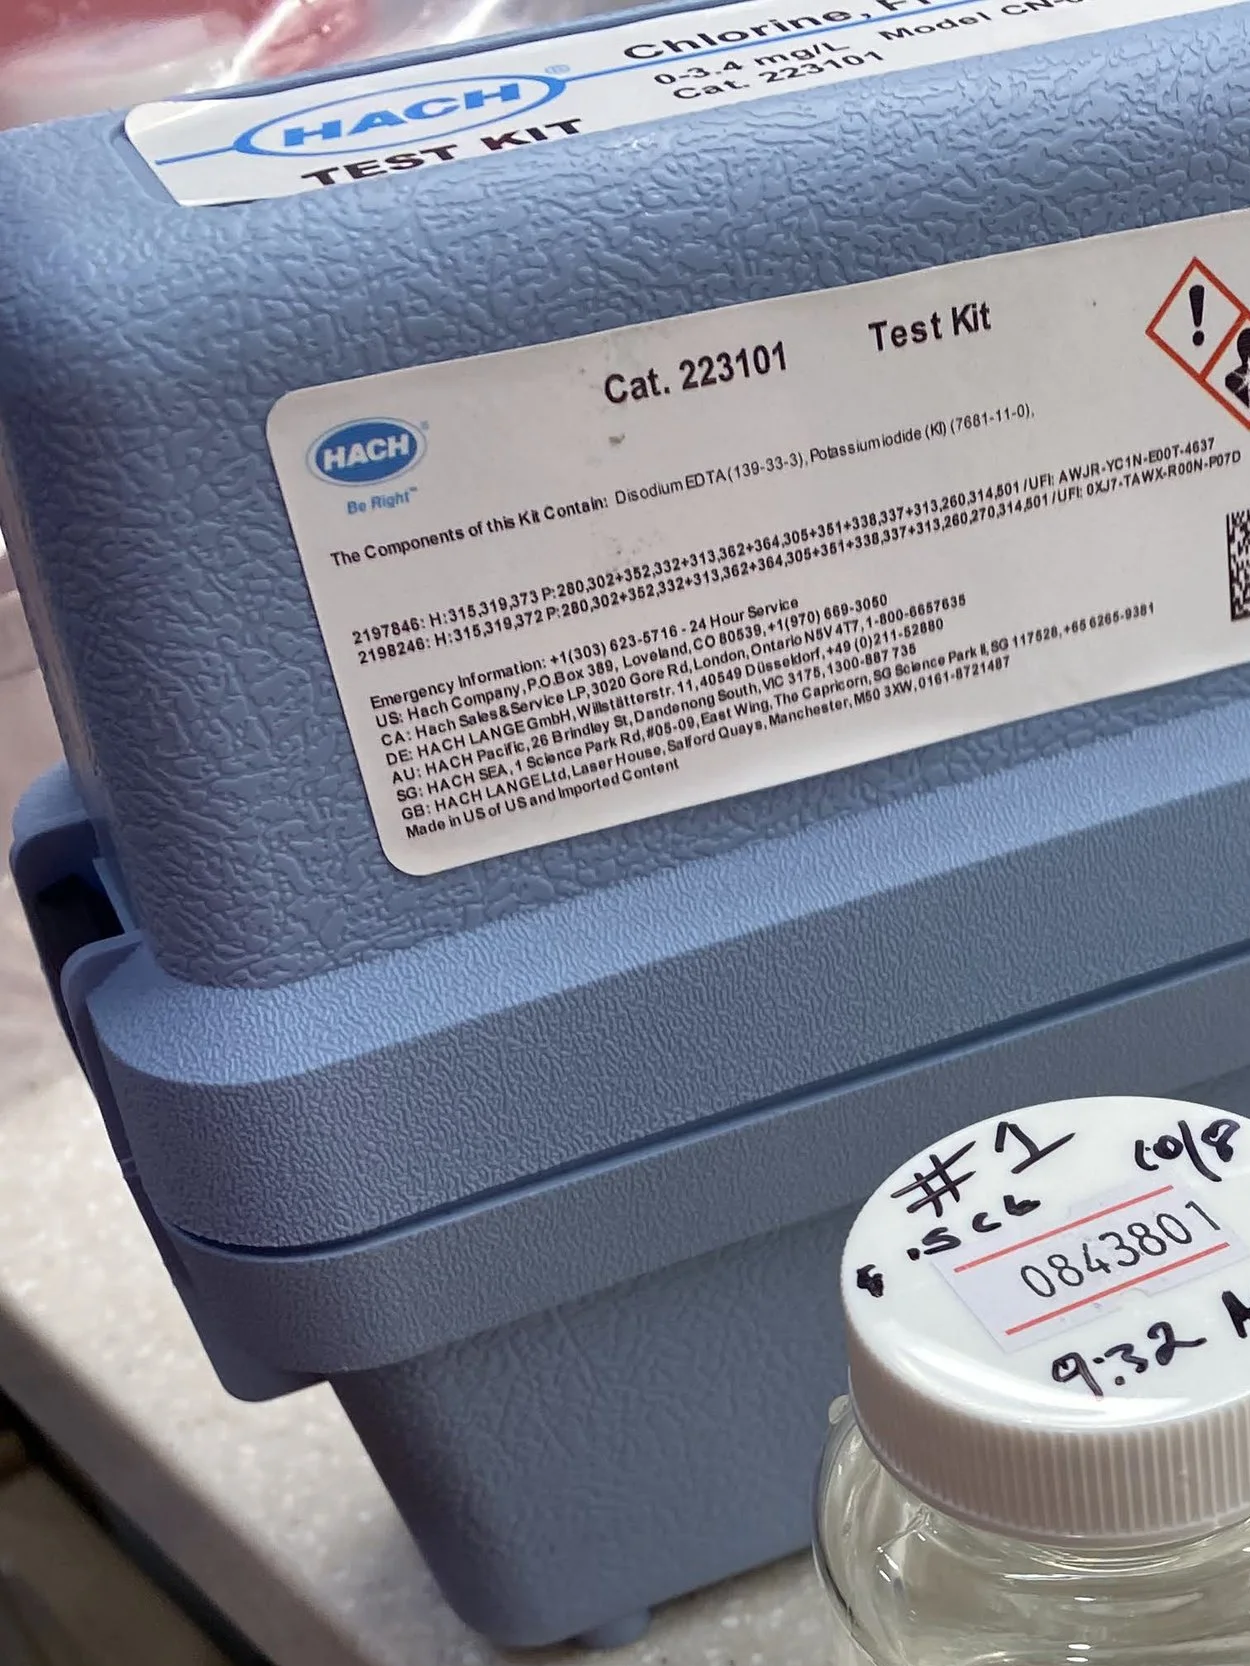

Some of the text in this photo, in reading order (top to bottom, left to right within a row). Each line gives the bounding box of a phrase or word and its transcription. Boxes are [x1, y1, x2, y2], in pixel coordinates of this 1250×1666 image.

[623, 10, 872, 61] Chlorine,
[653, 60, 743, 86] 0-3.4
[754, 42, 850, 70] mg/L
[878, 12, 993, 41] Model
[672, 49, 883, 100] Cat. 223101
[283, 82, 521, 148] HACH
[301, 118, 582, 186] TEST KIT
[867, 300, 992, 353] Test Kit
[603, 340, 787, 405] Cat. 223101
[323, 433, 411, 473] HACH
[329, 550, 361, 567] The
[363, 528, 466, 561] Components
[467, 520, 484, 538] of
[485, 515, 516, 534] this
[517, 509, 542, 527] Kit
[543, 495, 609, 521] Contain:
[614, 480, 684, 505] Disodium
[809, 437, 881, 463] Potassium
[881, 427, 922, 448] iodide
[950, 402, 1035, 436] (7681-11-0),
[346, 500, 367, 515] Be
[351, 616, 426, 646] 2197846:
[357, 636, 432, 665] 2198246:
[369, 598, 799, 711] Emergency Information: +1(303) 623-5716 24 Hour Service
[375, 710, 404, 729] US:
[406, 699, 449, 722] Hach
[450, 683, 527, 710] Company,
[586, 658, 619, 678] 389,
[621, 640, 692, 670] Loveland,
[692, 634, 716, 652] CO
[767, 609, 821, 633] +1(970)
[385, 748, 414, 767] DE:
[416, 734, 467, 760] HACH
[468, 719, 527, 746] LANGE
[526, 707, 577, 731] GmbH,
[676, 677, 699, 694] 11,
[699, 666, 743, 688] 40549
[826, 639, 852, 657] +49
[392, 766, 422, 786] AU:
[424, 751, 474, 777] HACH
[475, 740, 531, 764] Pacific,
[530, 732, 549, 751] 26
[551, 720, 610, 745] Brindley
[612, 714, 634, 729] St,
[632, 694, 716, 724] Dandenong
[717, 681, 762, 704] South,
[761, 674, 785, 692] VIC
[401, 803, 432, 821] GB:
[433, 788, 483, 813] HACH
[485, 772, 542, 800] LANGE
[541, 766, 572, 786] Ltd,
[570, 757, 614, 779] Laser
[614, 745, 667, 767] House,
[666, 728, 717, 755] Salford
[717, 719, 768, 740] Quays,
[768, 697, 853, 728] Manchester,
[405, 756, 680, 840] Made in US of US and Imported Content
[1020, 1201, 1221, 1298] 0843801
[1052, 1321, 1207, 1399] 9:32
